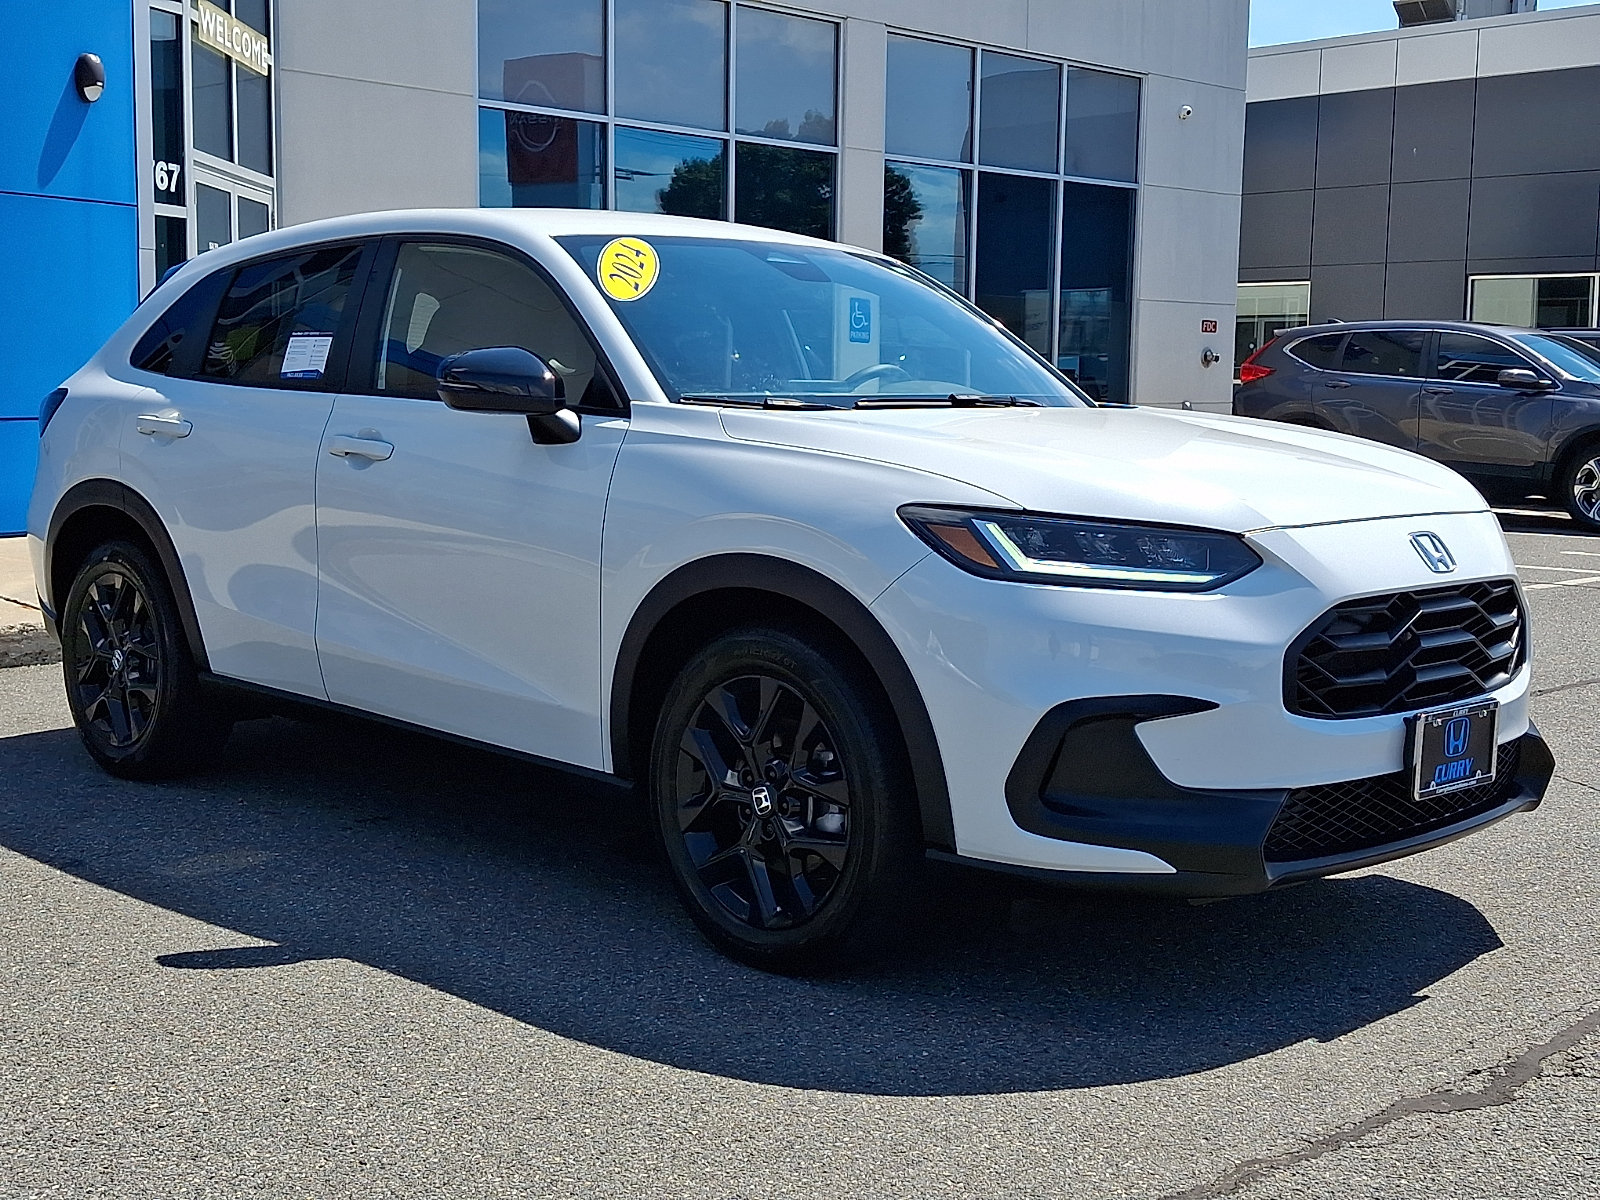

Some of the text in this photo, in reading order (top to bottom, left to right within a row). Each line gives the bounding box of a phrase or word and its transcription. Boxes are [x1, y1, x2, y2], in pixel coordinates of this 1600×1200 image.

[200, 5, 268, 68] WELCOME
[152, 160, 181, 192] 67
[608, 242, 647, 292] 2024
[1203, 322, 1216, 331] FDC
[1434, 757, 1474, 783] CURRY
